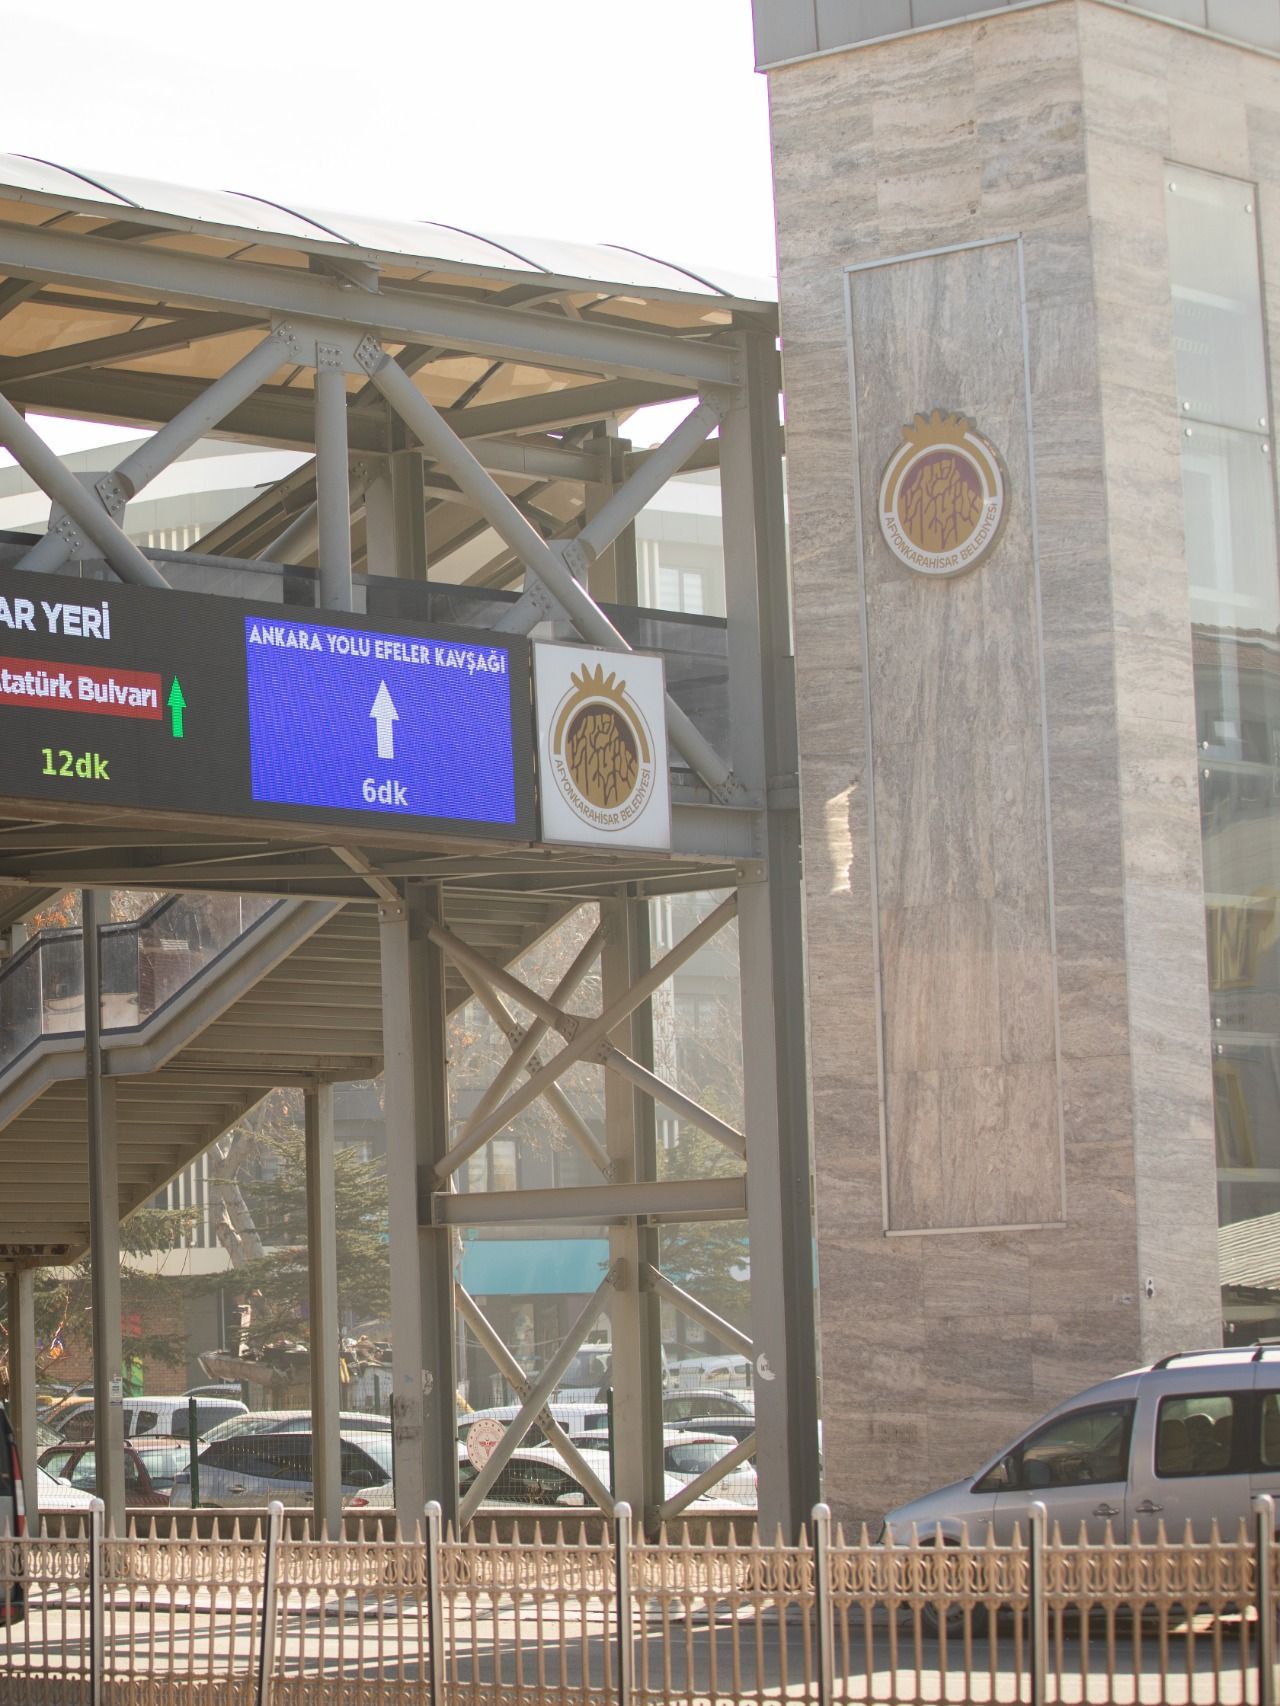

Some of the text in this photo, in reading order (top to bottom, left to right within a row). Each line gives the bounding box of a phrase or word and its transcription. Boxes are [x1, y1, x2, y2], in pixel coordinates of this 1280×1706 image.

[40, 601, 111, 639] YERİ
[249, 624, 506, 675] ANKARA YOLU EFELER KAVŞAĞI
[77, 675, 157, 708] Bulvarı
[41, 748, 111, 780] 12dk
[362, 778, 408, 806] 6dk
[554, 759, 620, 825] AFYONKARAHİSAR
